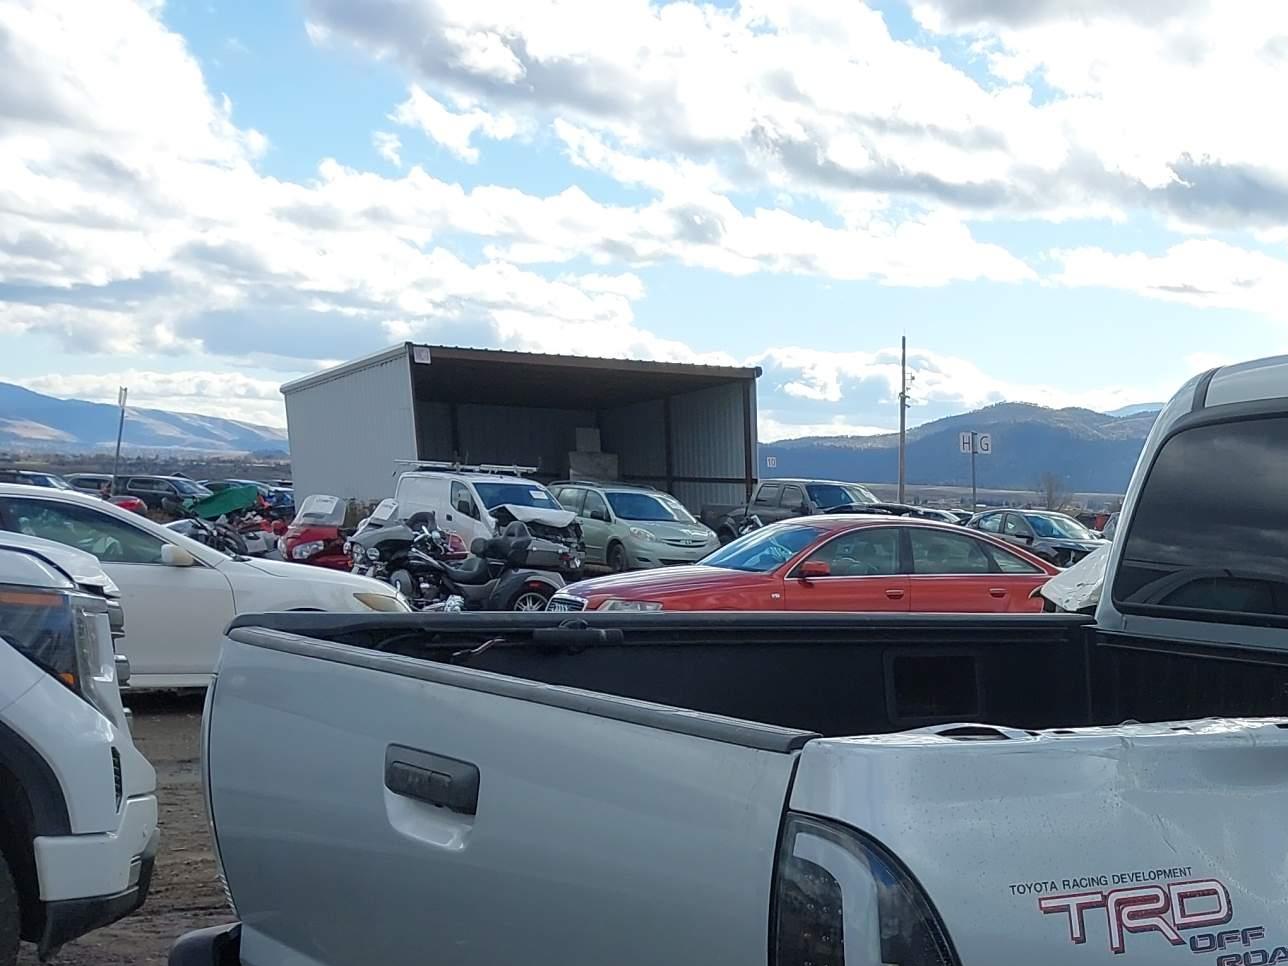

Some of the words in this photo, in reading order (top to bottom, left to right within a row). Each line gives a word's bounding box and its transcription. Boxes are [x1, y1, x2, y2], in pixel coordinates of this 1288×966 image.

[962, 434, 971, 451] H
[980, 435, 989, 452] G
[1009, 881, 1058, 895] TOYOTA
[1062, 875, 1109, 890] RACING
[1112, 867, 1192, 884] DEVELOPMENT
[1038, 878, 1233, 954] TRD
[1189, 925, 1266, 954] OFF
